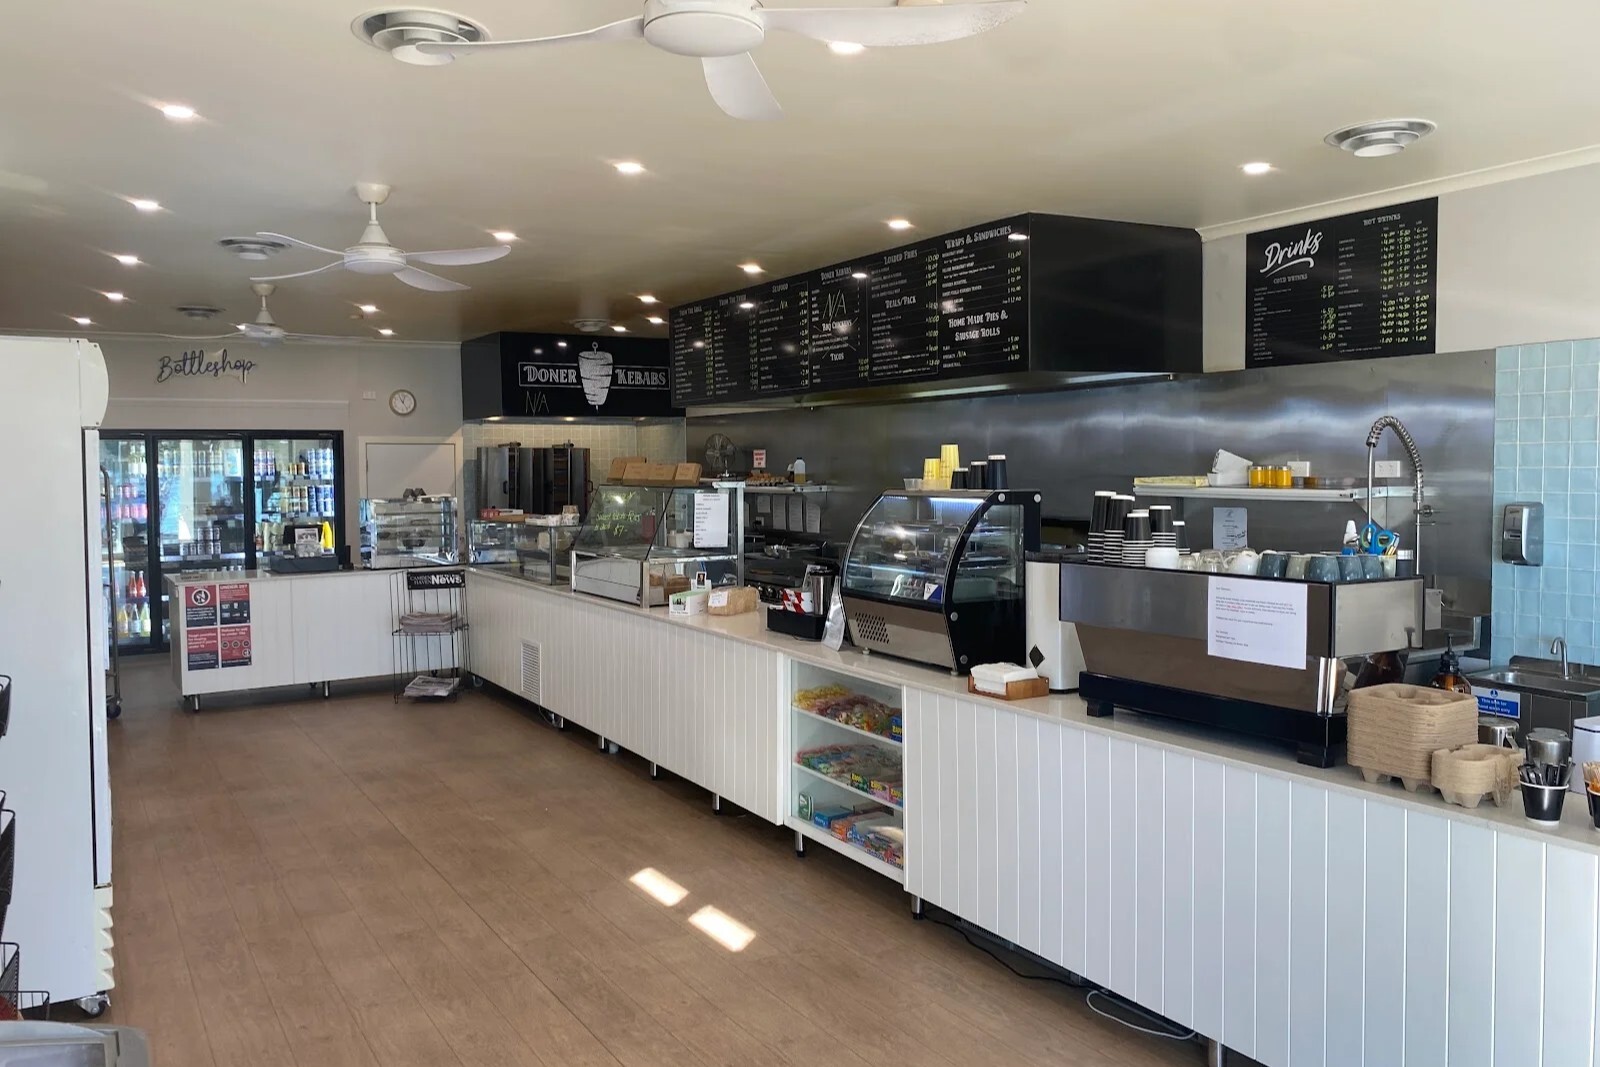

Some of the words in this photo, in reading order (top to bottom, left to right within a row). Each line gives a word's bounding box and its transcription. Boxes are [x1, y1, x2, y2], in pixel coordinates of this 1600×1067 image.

[945, 237, 964, 249] WRAPS
[966, 234, 973, 244] &
[974, 225, 1011, 242] SANDWICHES
[1260, 228, 1323, 273] Drinks
[948, 317, 965, 328] HOME
[966, 314, 983, 325] MADE
[985, 312, 999, 322] PIES
[1000, 310, 1008, 320] &
[955, 330, 979, 341] SAUSAGE
[980, 327, 1000, 337] ROLLS
[157, 348, 256, 384] Bottleshop
[524, 365, 577, 383] DONER
[615, 369, 666, 385] KEBABS
